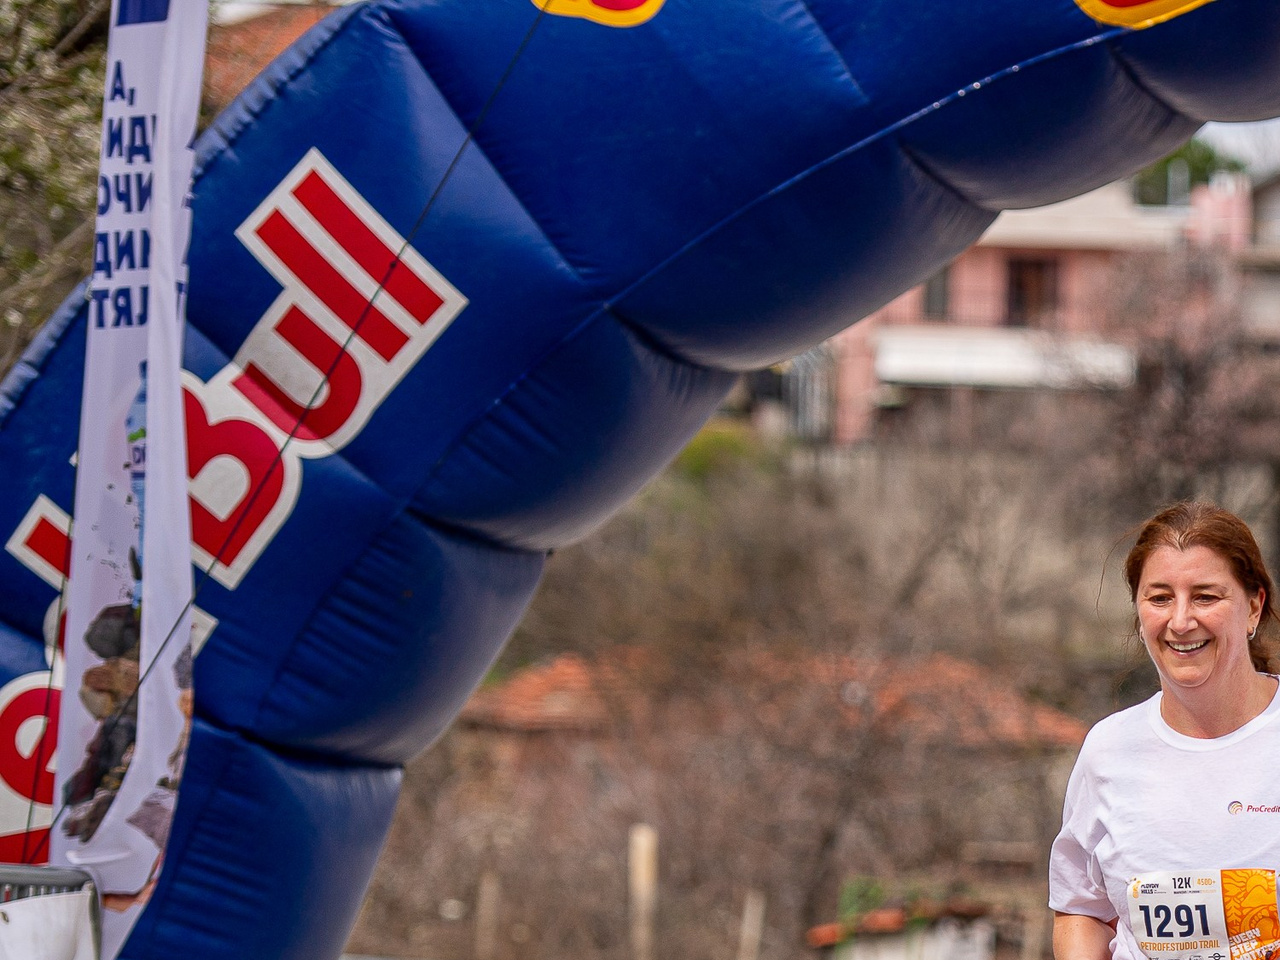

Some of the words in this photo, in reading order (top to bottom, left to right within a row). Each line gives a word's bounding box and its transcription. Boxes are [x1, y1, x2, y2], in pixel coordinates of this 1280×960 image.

[183, 158, 456, 578] Bull
[1246, 804, 1280, 813] ProCredit
[1172, 877, 1191, 889] 12K
[1139, 904, 1210, 938] 1291
[1199, 939, 1220, 949] TRAIL
[1230, 939, 1258, 956] STEP
